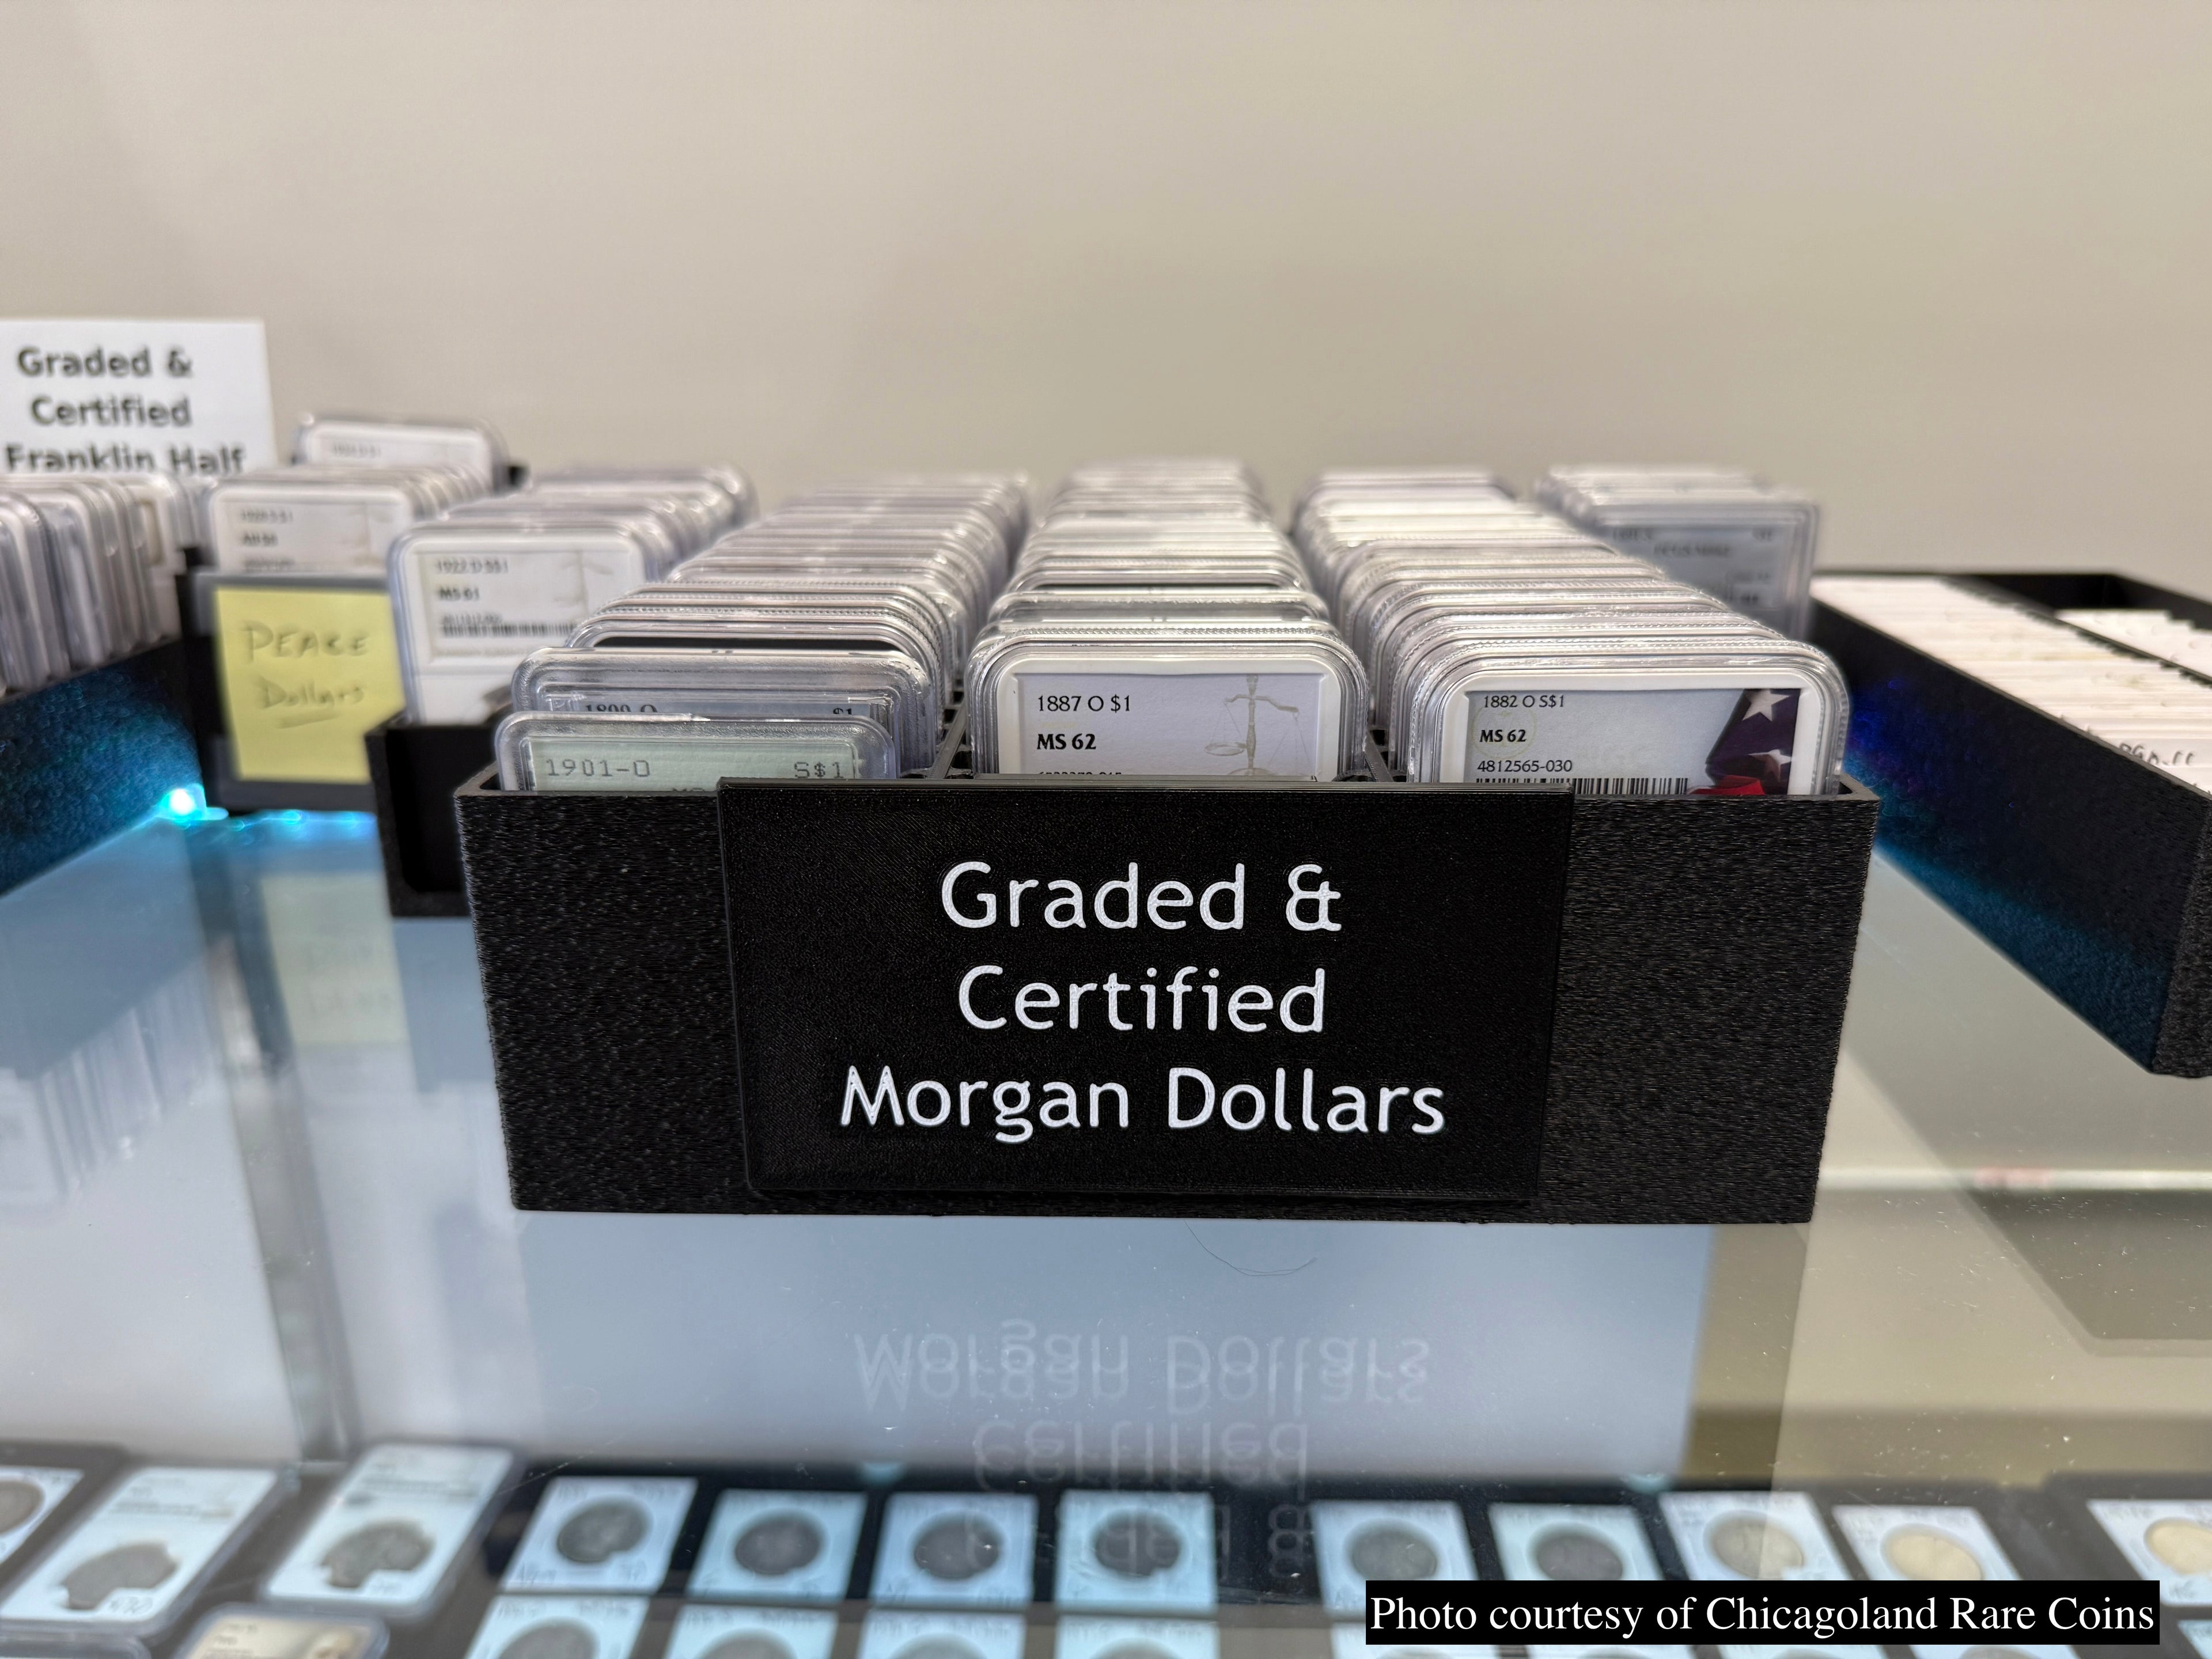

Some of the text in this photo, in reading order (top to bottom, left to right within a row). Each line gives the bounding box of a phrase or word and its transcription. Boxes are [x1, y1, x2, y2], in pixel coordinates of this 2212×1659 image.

[17, 344, 193, 378] Graded &
[31, 394, 192, 428] Certified
[5, 441, 244, 473] Franklin Half
[1038, 694, 1130, 713] 1887 O $1
[1484, 695, 1565, 709] 1882 O S$1
[1037, 733, 1097, 750] MS 62
[1479, 729, 1527, 743] MS 62
[794, 762, 844, 778] S$1
[1477, 759, 1573, 772] 4812565-030
[942, 862, 1341, 931] Graded &
[959, 965, 1324, 1032] Certified
[842, 1066, 1443, 1142] Morgan Dollars
